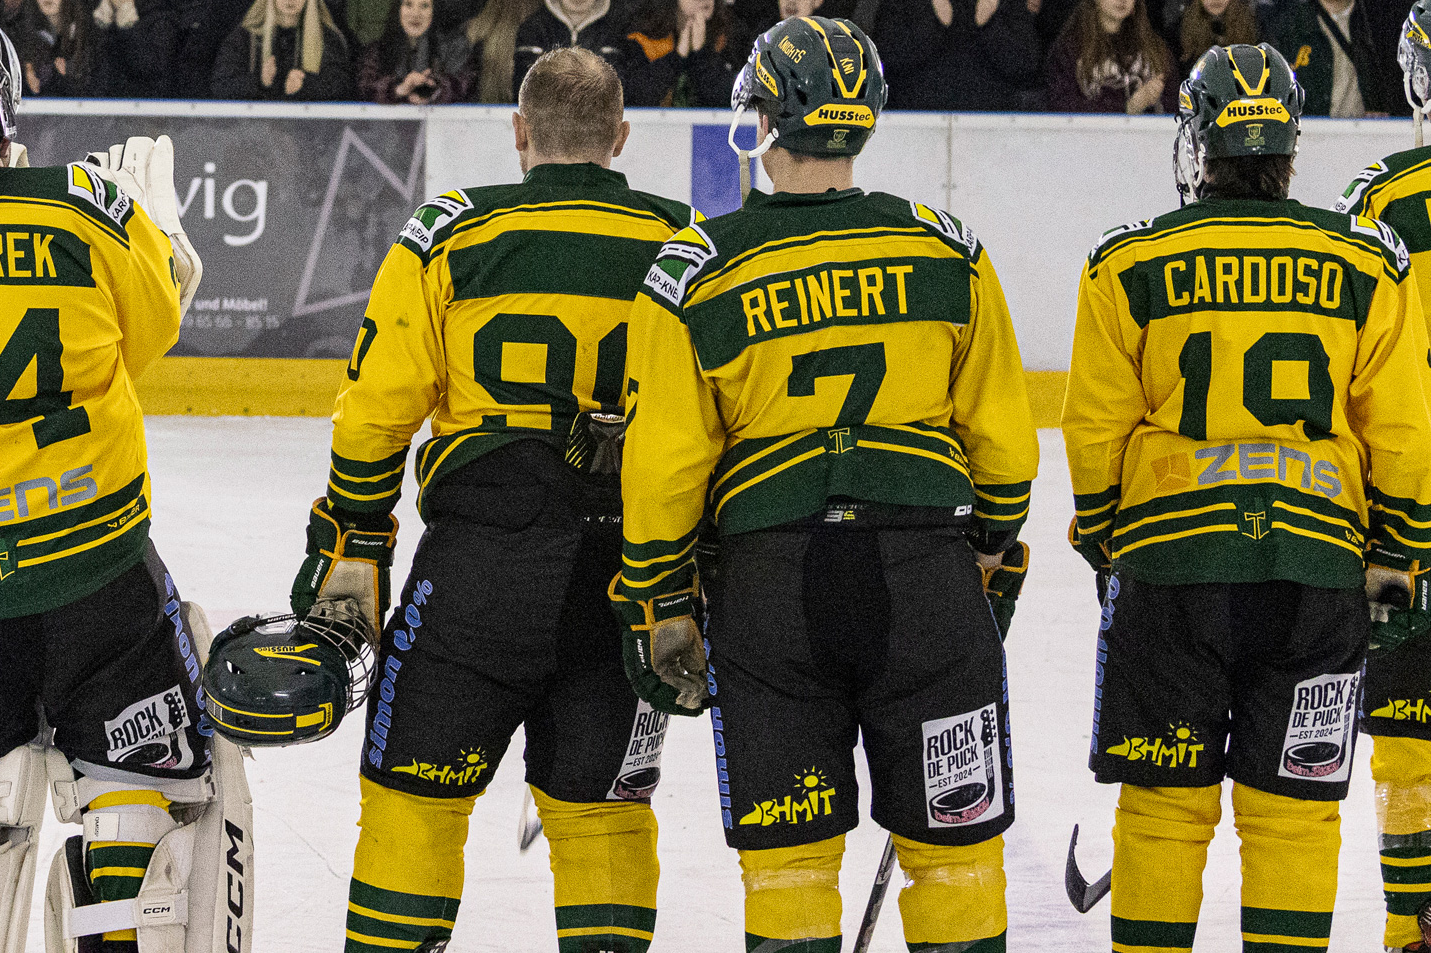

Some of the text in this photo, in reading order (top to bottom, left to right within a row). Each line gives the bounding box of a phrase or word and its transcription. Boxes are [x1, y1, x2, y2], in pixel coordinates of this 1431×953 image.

[778, 35, 807, 64] KNIGHTS
[818, 108, 871, 122] HUSStec
[1226, 104, 1283, 118] HUSStec
[1163, 254, 1345, 310] CARDOSO
[739, 264, 914, 338] REINERT
[787, 342, 887, 427] 7
[1177, 330, 1339, 442] 19
[351, 537, 384, 547] BAUER
[310, 558, 325, 589] BAUER
[1297, 679, 1349, 711] ROCK
[110, 701, 165, 752] ROCK
[369, 654, 403, 769] simon
[1292, 707, 1343, 728] DE PUCK
[628, 738, 645, 757] DE
[926, 716, 976, 761] ROCK
[1298, 727, 1334, 740] EST 2024
[927, 746, 980, 780] DE PUCK
[938, 768, 973, 789] EST 2024
[143, 905, 171, 915] CCM
